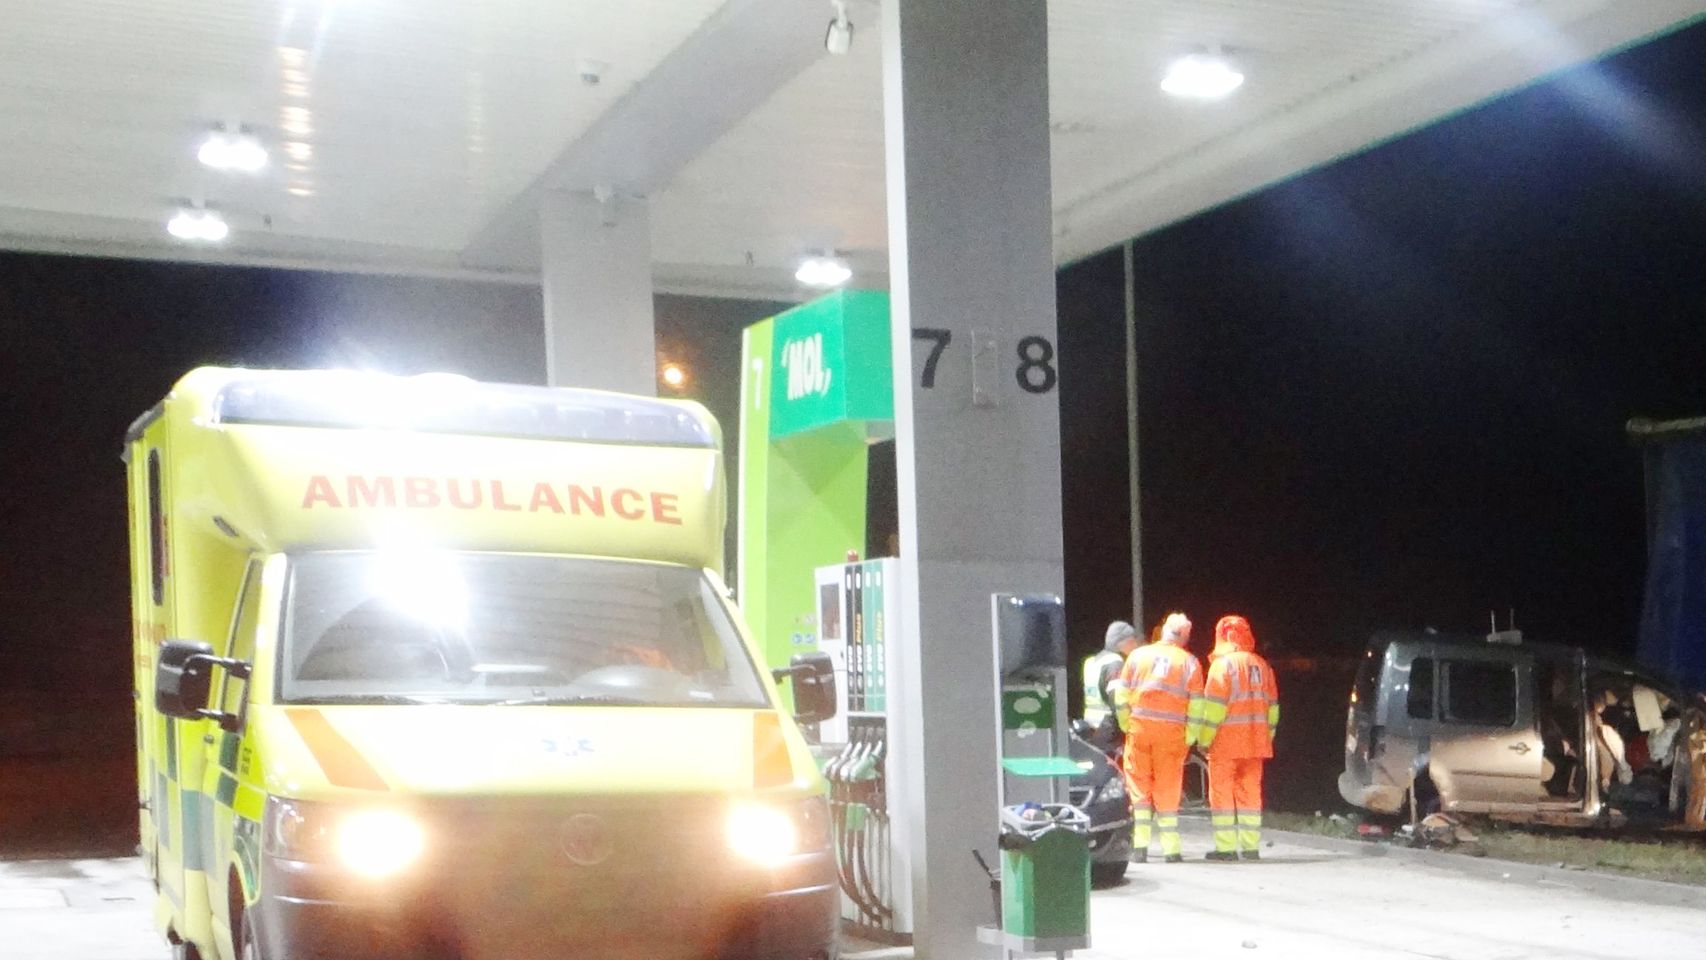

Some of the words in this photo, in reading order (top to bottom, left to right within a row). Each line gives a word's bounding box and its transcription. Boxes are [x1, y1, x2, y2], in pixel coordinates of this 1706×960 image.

[752, 358, 764, 411] 7
[911, 328, 952, 388] 7
[1016, 336, 1057, 394] 8
[301, 474, 683, 526] AMBULANCE
